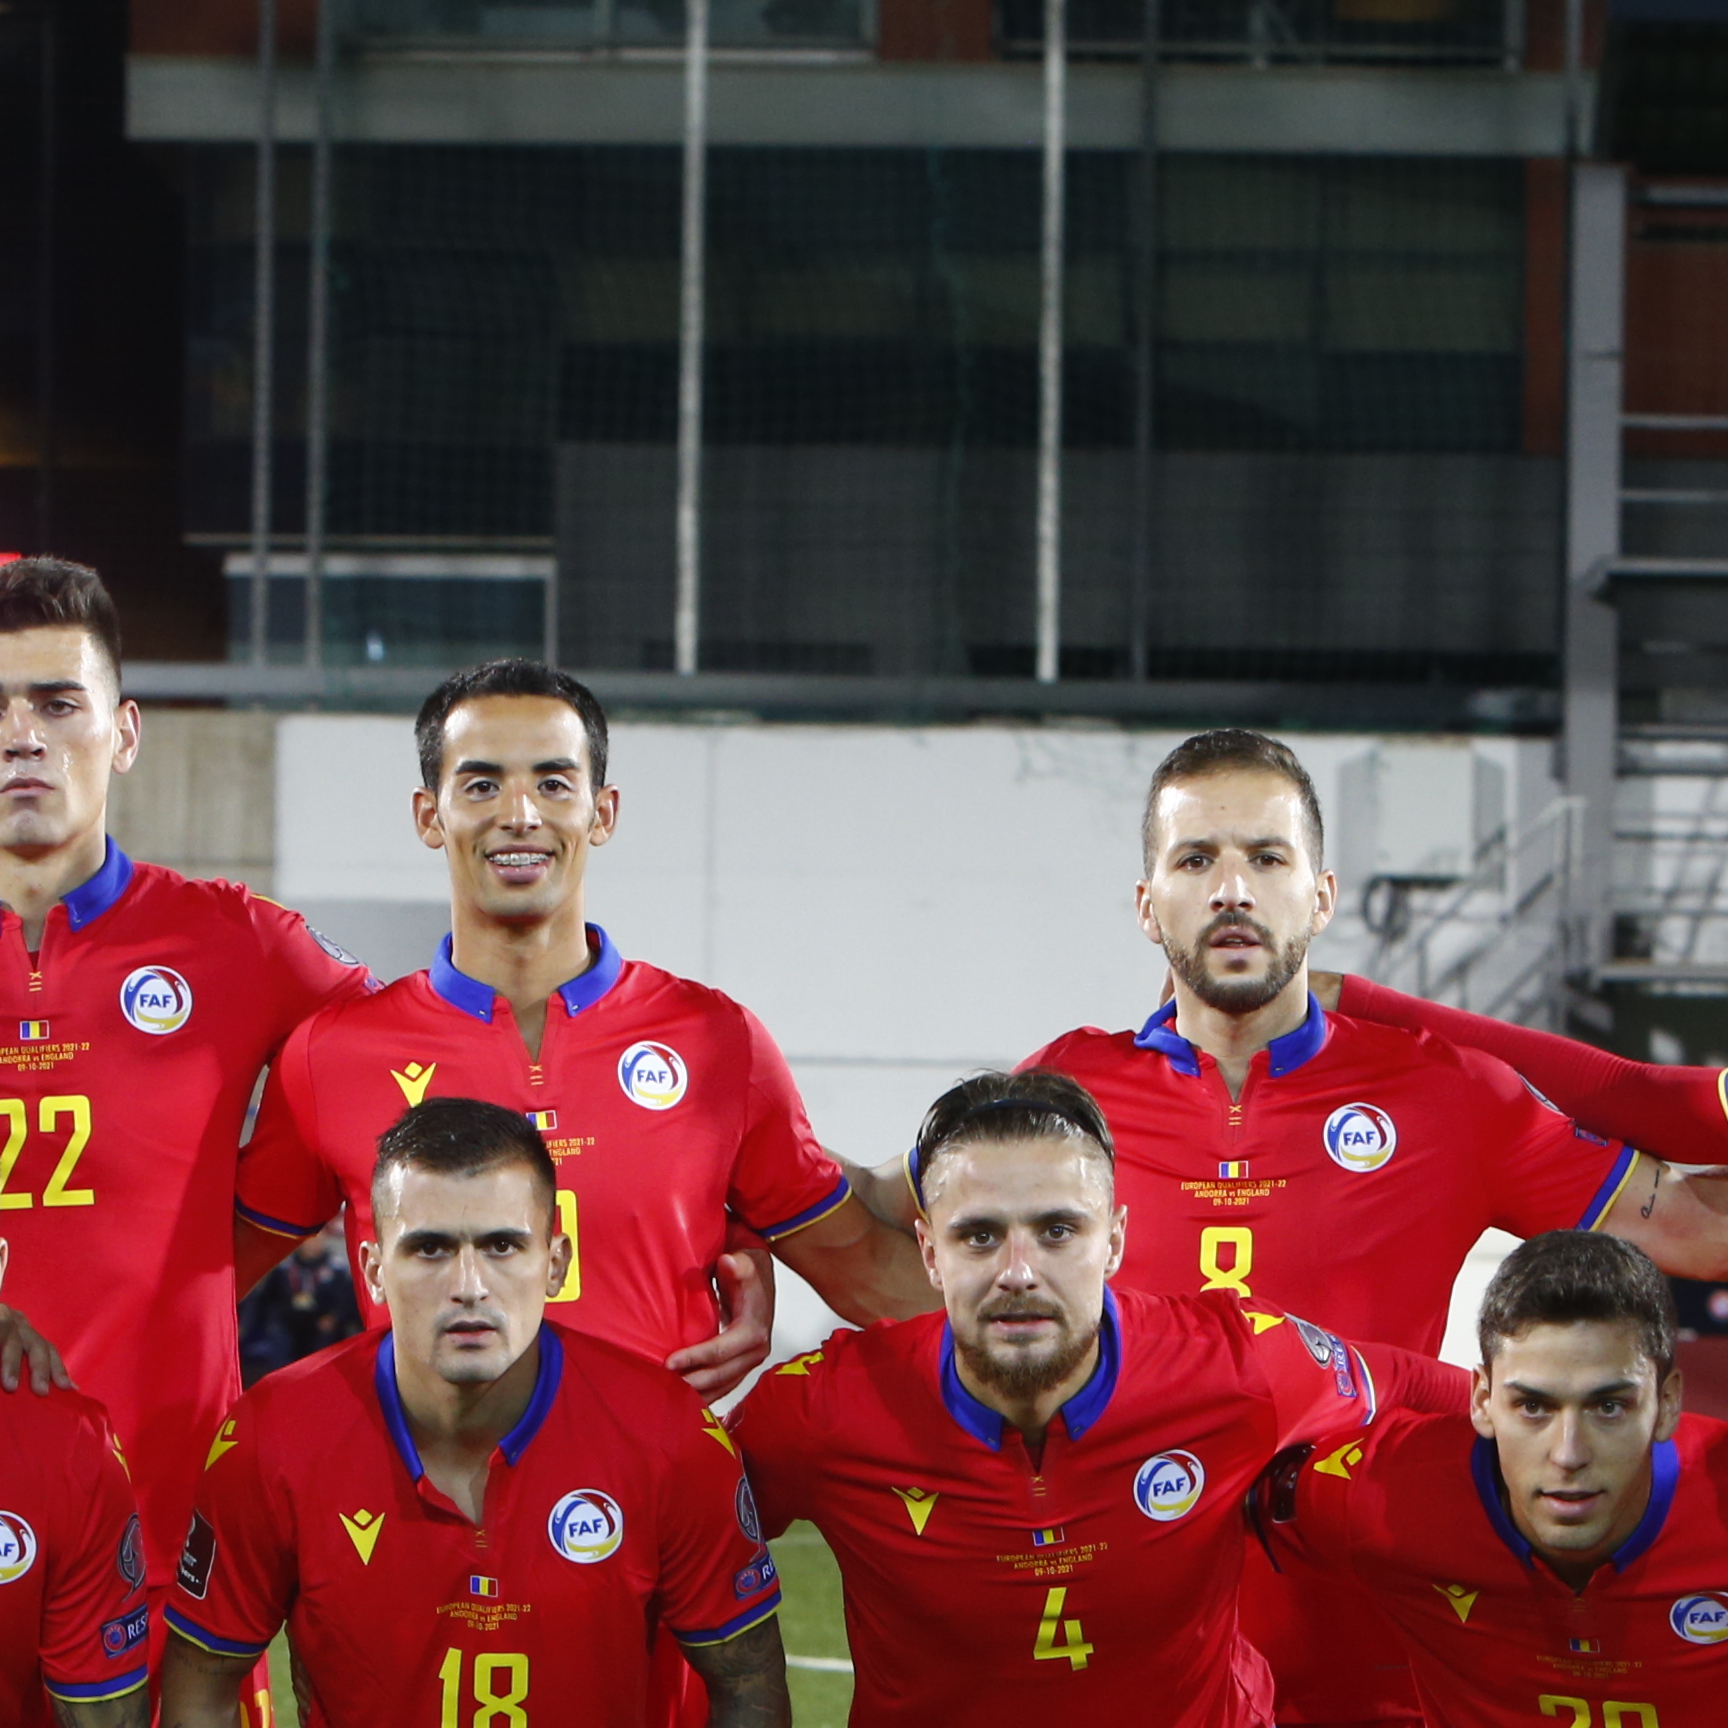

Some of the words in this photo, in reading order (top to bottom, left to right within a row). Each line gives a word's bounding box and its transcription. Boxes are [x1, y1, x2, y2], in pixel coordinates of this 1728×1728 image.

[139, 994, 173, 1008] FAF
[21, 1044, 60, 1054] QUALIFIERS
[62, 1042, 90, 1051] 2021-22
[41, 1052, 74, 1062] ENGLAND
[17, 1062, 54, 1072] 09-10-2021
[637, 1070, 668, 1084] FAF
[569, 1136, 595, 1147] 2021-22
[1343, 1132, 1375, 1146] FAF
[1181, 1181, 1216, 1190] EUROPEAN
[1217, 1181, 1257, 1189] QUALIFIERS
[1258, 1180, 1286, 1188] 2021-22
[1194, 1189, 1227, 1198] ANDORRA
[1237, 1189, 1270, 1197] ENGLAND
[1213, 1198, 1250, 1206] 09-10-2021
[1199, 1226, 1252, 1299] 8
[1152, 1475, 1186, 1497] FAF
[568, 1518, 603, 1538] FAF
[996, 1554, 1035, 1562] EUROPEAN
[1080, 1542, 1108, 1554] 2021-22
[1014, 1560, 1048, 1570] ANDORRA
[1059, 1554, 1093, 1564] ENGLAND
[1034, 1564, 1074, 1576] 09-10-2021
[487, 1612, 518, 1622] ENGLAND
[1689, 1609, 1728, 1626] FAF
[1033, 1587, 1094, 1671] 4
